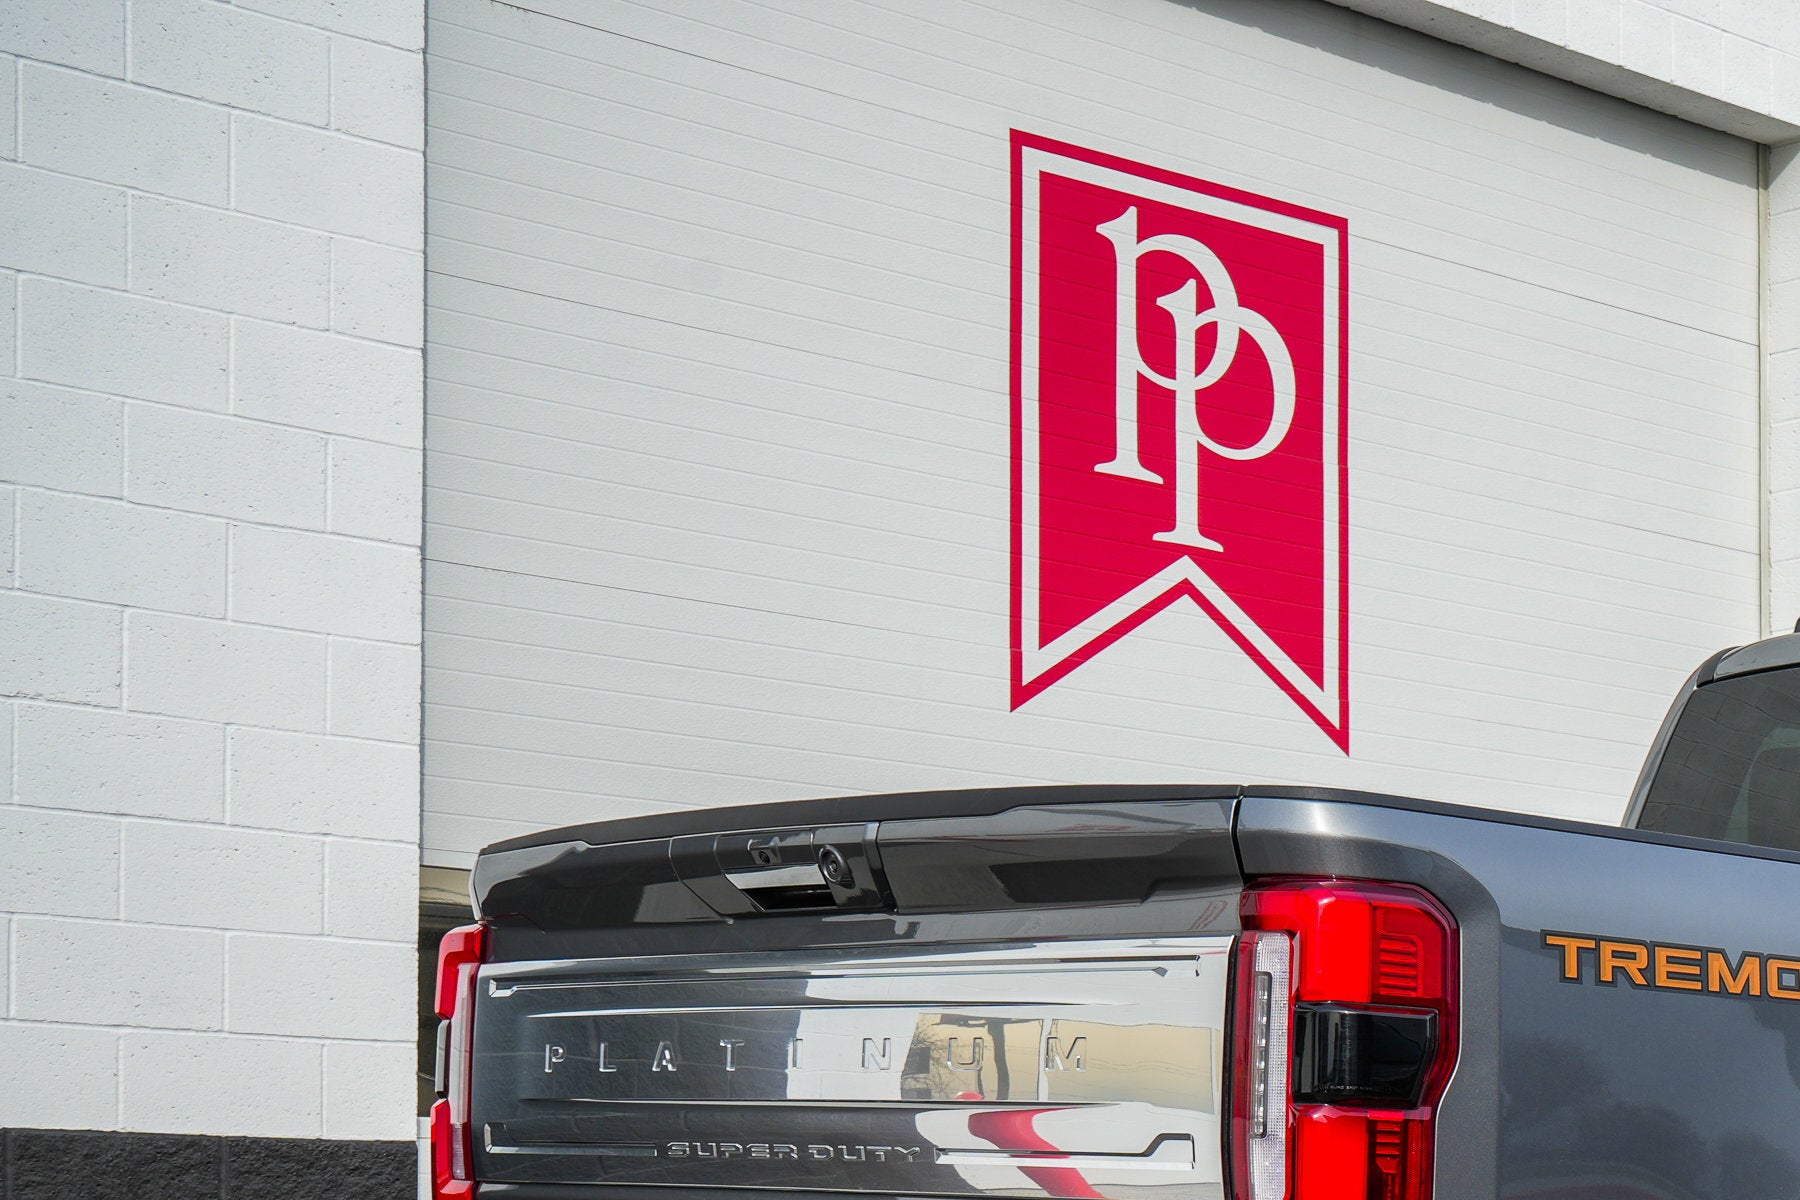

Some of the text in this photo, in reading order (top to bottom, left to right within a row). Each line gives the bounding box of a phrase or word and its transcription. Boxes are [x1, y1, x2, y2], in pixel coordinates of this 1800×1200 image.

[544, 1036, 1088, 1073] PLATINUM
[667, 1141, 921, 1163] SUPER DUTY
